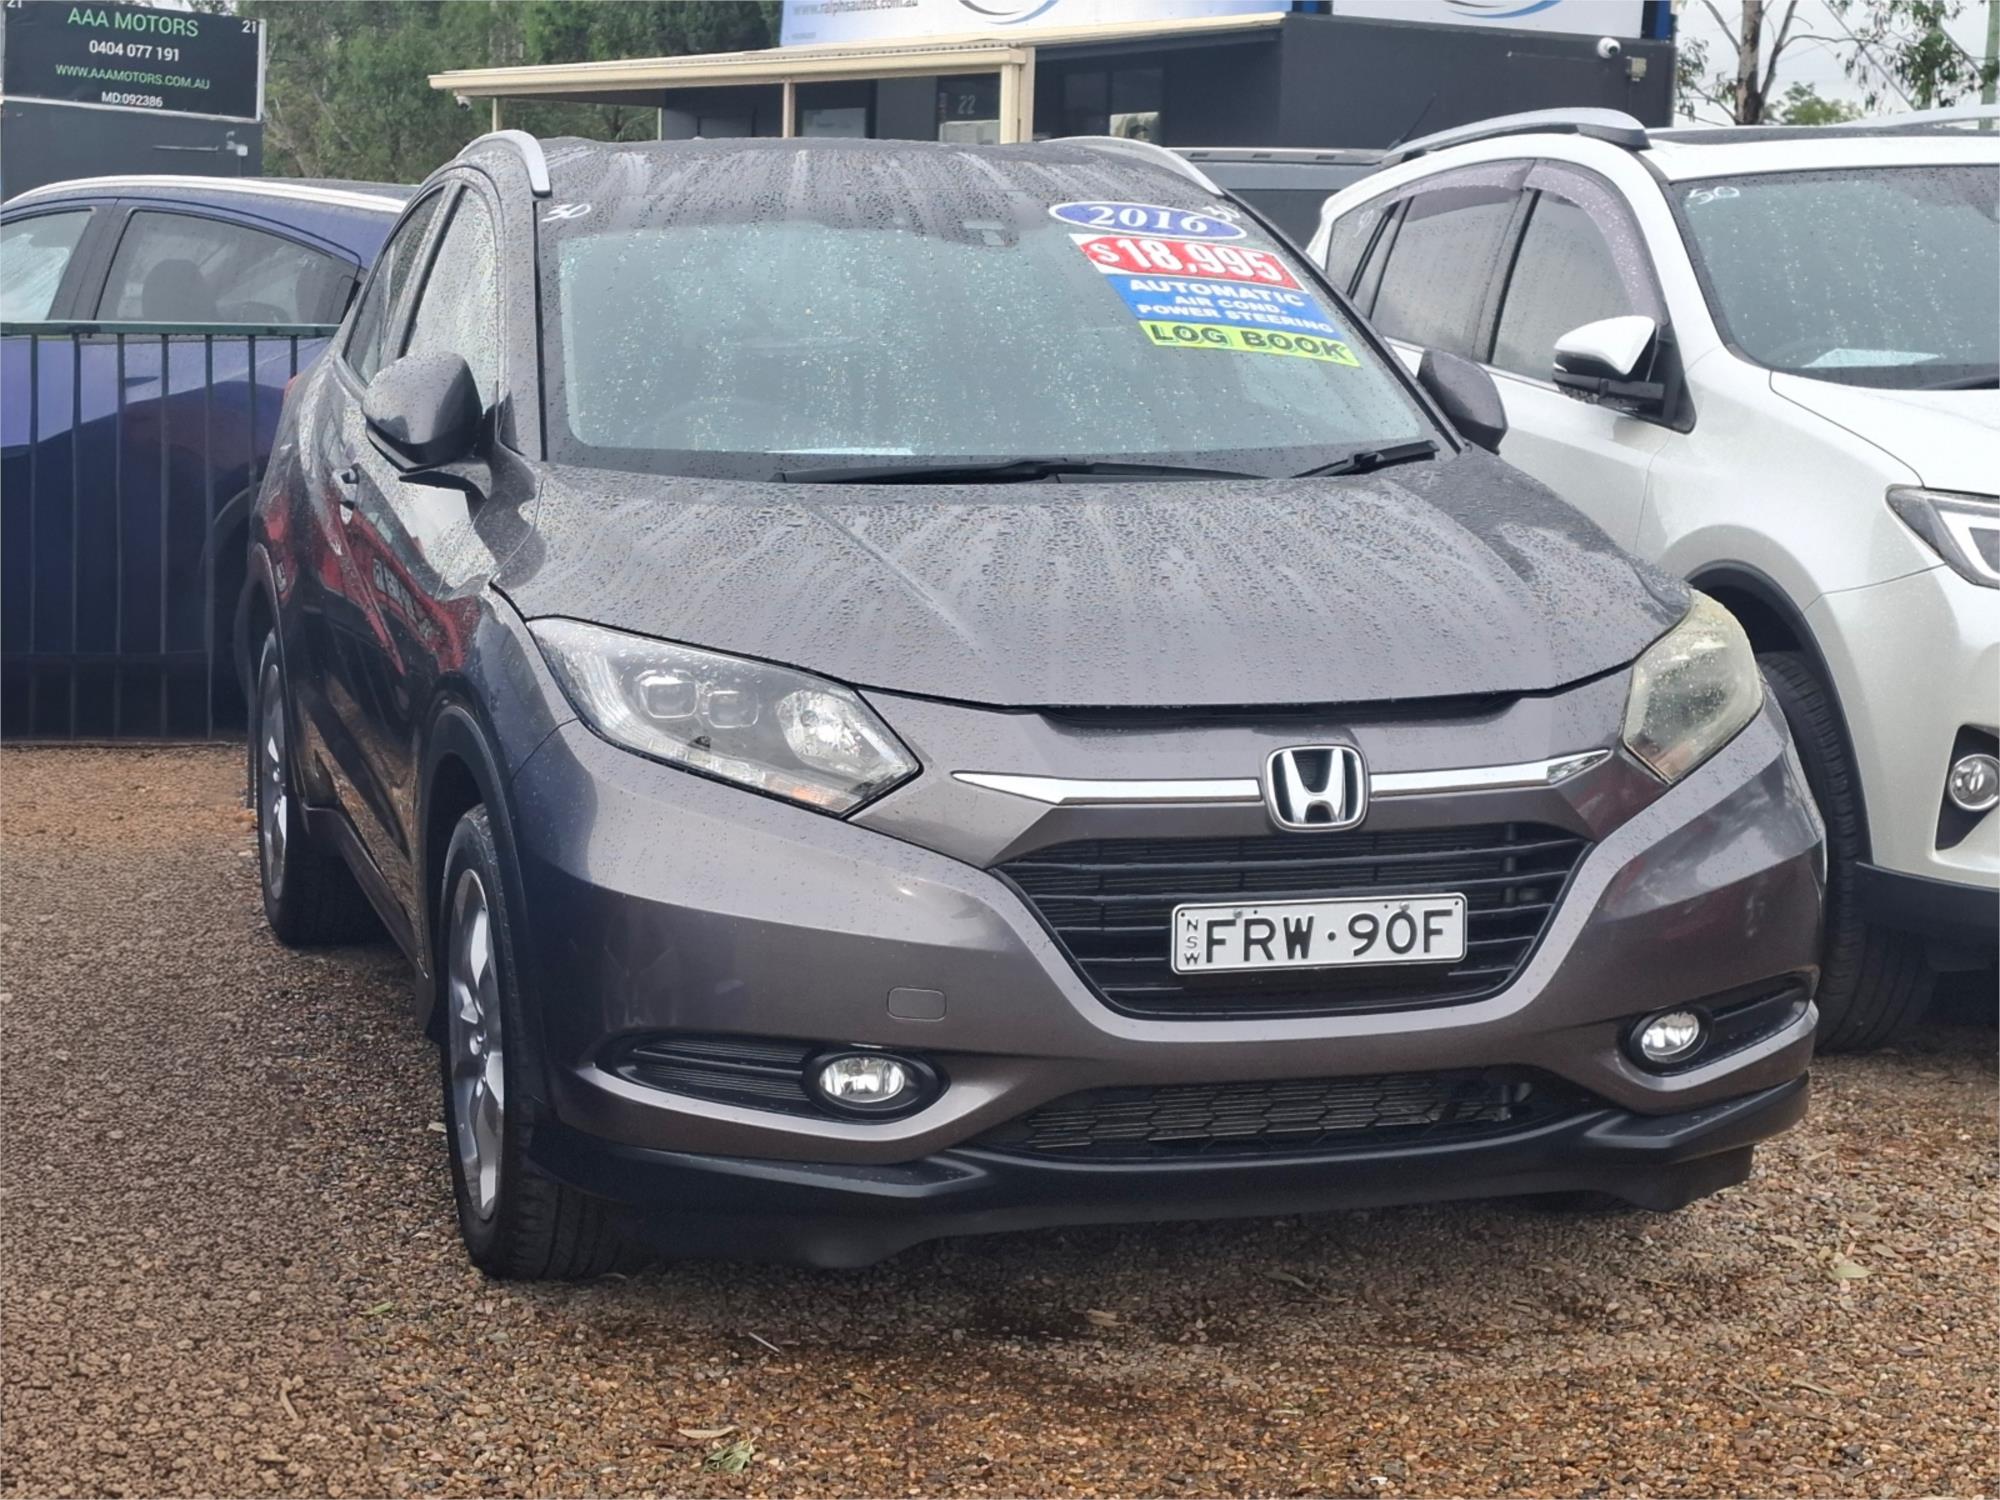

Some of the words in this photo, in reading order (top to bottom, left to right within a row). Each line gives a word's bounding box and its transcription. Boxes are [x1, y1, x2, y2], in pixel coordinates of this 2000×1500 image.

[67, 7, 109, 28] AAA
[115, 12, 199, 37] MOTORS
[242, 20, 257, 34] 21
[89, 40, 124, 56] 0404
[127, 43, 152, 58] 077
[157, 47, 180, 62] 191
[55, 64, 210, 89] WWW.AAAMOTORS.COM.AU
[1089, 206, 1208, 233] 2016
[1089, 238, 1283, 281] $18,995
[1130, 279, 1304, 307] AUTOMATIC
[1175, 295, 1215, 306] AIR
[1218, 299, 1288, 315] COND.
[1137, 304, 1221, 318] POWER
[1225, 309, 1334, 334] STEERING
[1150, 323, 1229, 344] LOG
[1241, 330, 1349, 359] BOOK
